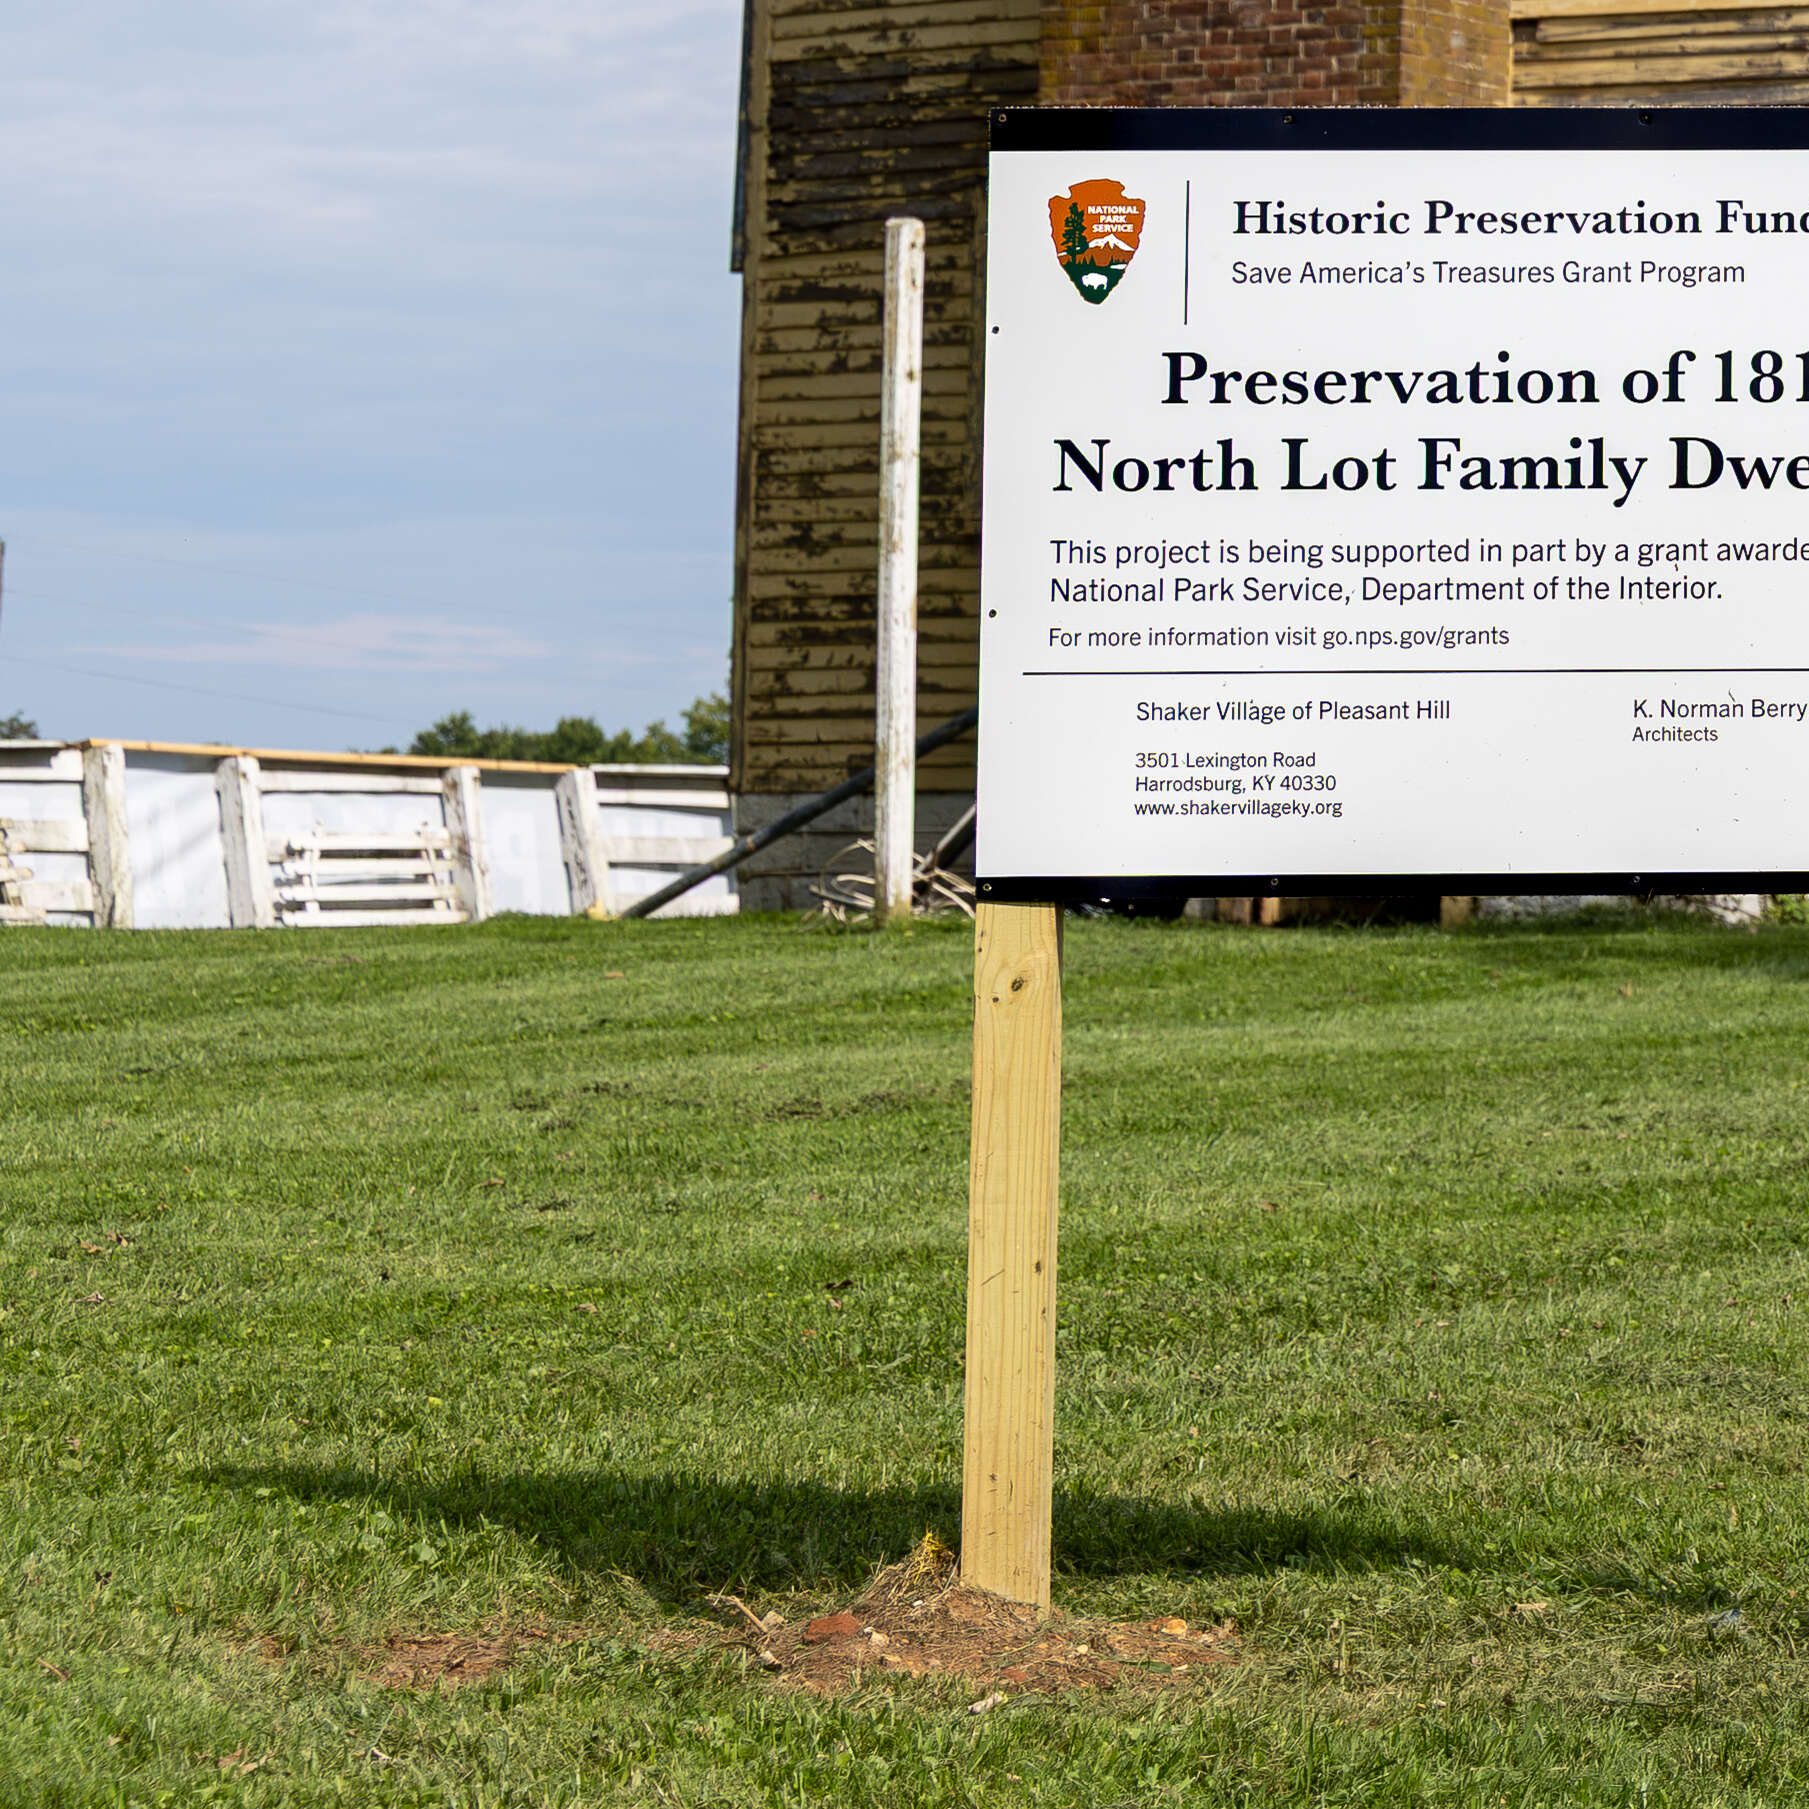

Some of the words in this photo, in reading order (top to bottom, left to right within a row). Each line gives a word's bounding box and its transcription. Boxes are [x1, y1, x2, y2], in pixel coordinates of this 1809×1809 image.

[1087, 205, 1139, 214] NATIONAL
[1100, 215, 1126, 223] PARK
[1233, 201, 1409, 234] Historic
[1424, 200, 1702, 234] Preservation
[1092, 224, 1133, 232] SERVICE
[1233, 262, 1291, 283] Save
[1300, 262, 1424, 283] America's
[1433, 261, 1554, 283] Treasures
[1563, 261, 1631, 282] Grant
[1641, 261, 1744, 287] Program
[1162, 351, 1599, 404] Preservation
[1623, 350, 1696, 403] of
[1053, 438, 1258, 492] North
[1281, 439, 1396, 491] Lot
[1418, 437, 1648, 507] Family
[1050, 540, 1106, 563] This
[1116, 540, 1210, 568] project
[1220, 540, 1239, 563] is
[1249, 539, 1323, 568] being
[1332, 539, 1469, 567] supported
[1479, 539, 1501, 562] in
[1513, 539, 1566, 567] part
[1576, 538, 1606, 567] by
[1615, 544, 1628, 562] a
[1638, 541, 1708, 567] grant
[1051, 578, 1163, 602] National
[1175, 578, 1234, 601] Park
[1243, 577, 1350, 605] Service,
[1363, 577, 1524, 605] Department
[1534, 576, 1559, 599] of
[1567, 576, 1609, 599] the
[1618, 576, 1721, 599] Interior.
[1050, 628, 1081, 646] For
[1089, 632, 1141, 646] more
[1149, 627, 1268, 645] information
[1276, 627, 1316, 645] visit
[1323, 626, 1509, 649] go.nps.gov/grants
[1137, 702, 1210, 720] Shaker
[1217, 701, 1285, 724] Village
[1293, 701, 1312, 719] of
[1320, 701, 1409, 719] Pleasant
[1417, 701, 1449, 718] Hill
[1634, 700, 1652, 717] K.
[1661, 699, 1743, 717] Norman
[1752, 699, 1807, 721] Berry
[1633, 727, 1718, 741] Architects
[1136, 753, 1179, 768] 3501
[1187, 753, 1266, 771] Lexington
[1274, 752, 1315, 767] Road
[1136, 777, 1245, 794] Harrodsburg,
[1253, 775, 1275, 791] KY
[1280, 775, 1336, 791] 40330
[1135, 800, 1342, 818] www.shakervillageky.org
